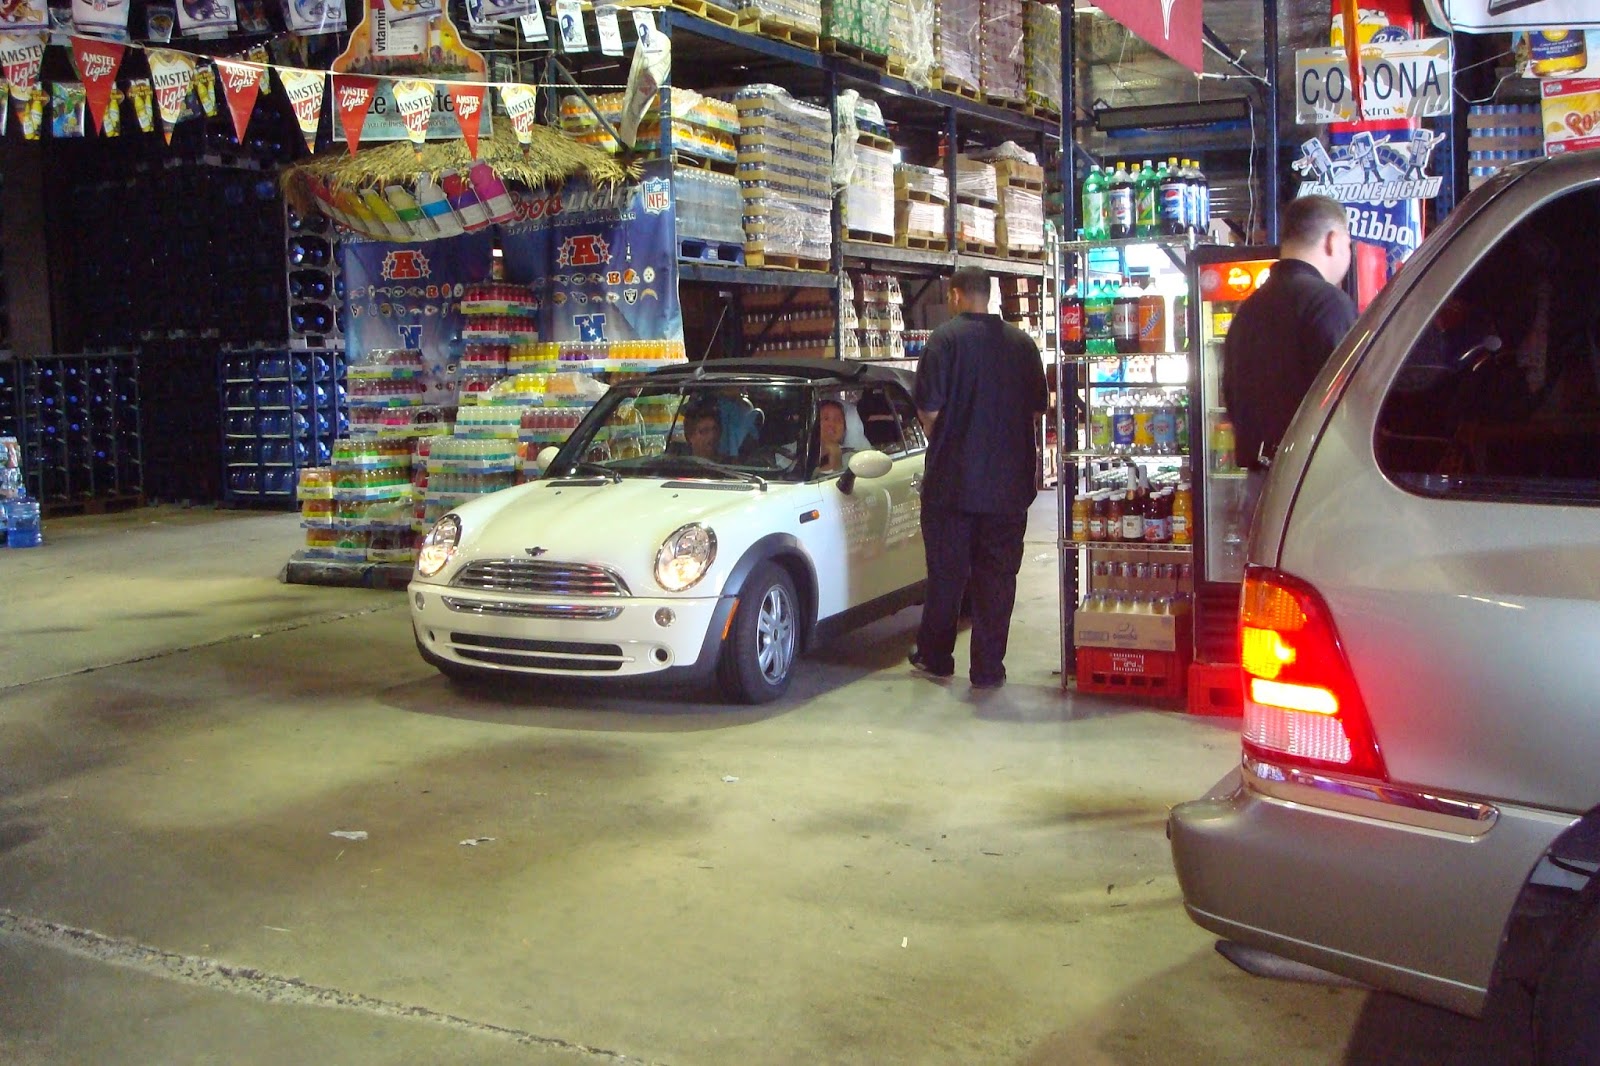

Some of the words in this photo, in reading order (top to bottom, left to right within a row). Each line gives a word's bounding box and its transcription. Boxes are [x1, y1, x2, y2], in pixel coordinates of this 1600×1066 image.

[375, 9, 386, 52] vitamin
[81, 51, 116, 66] AMSTEL
[225, 66, 258, 79] AMSTEL
[340, 86, 369, 97] AMSTEL
[456, 95, 480, 105] AMSTEL
[1299, 182, 1384, 200] KEYSTONE
[1383, 178, 1438, 199] LIGHT
